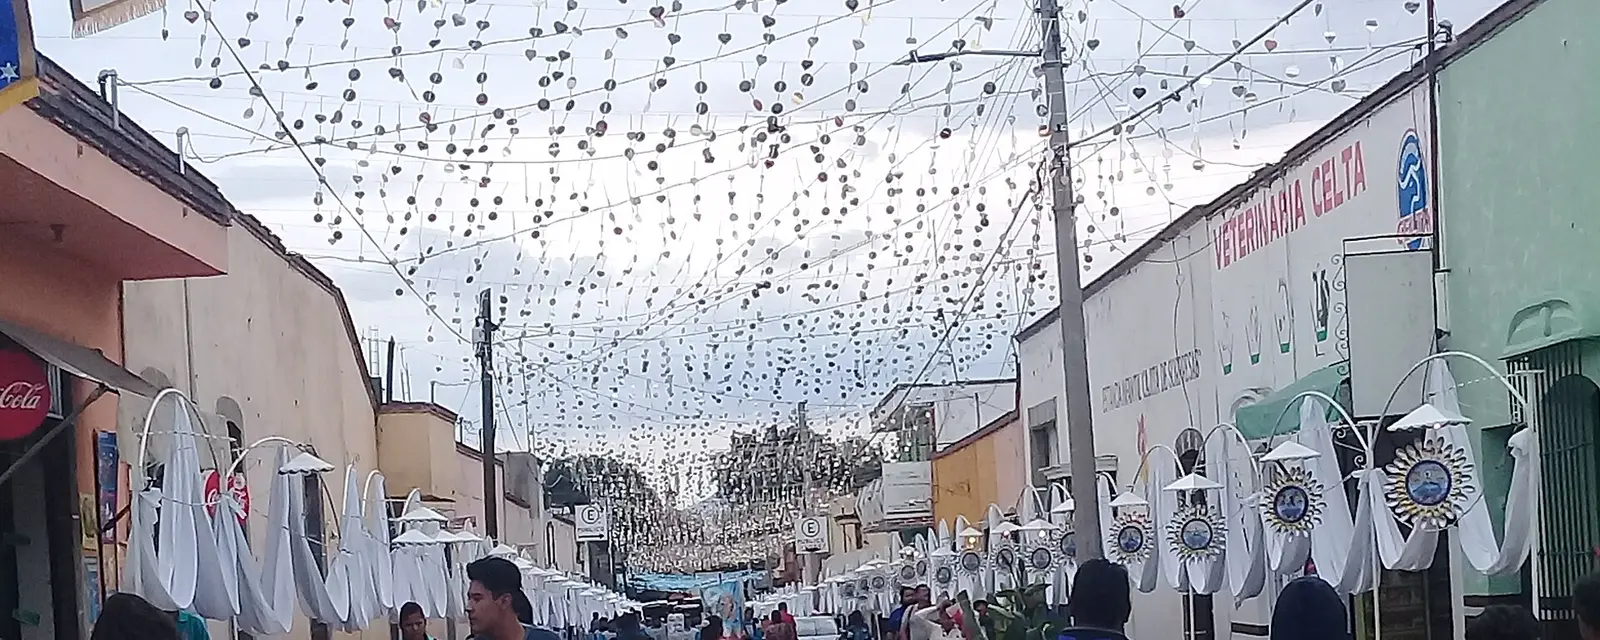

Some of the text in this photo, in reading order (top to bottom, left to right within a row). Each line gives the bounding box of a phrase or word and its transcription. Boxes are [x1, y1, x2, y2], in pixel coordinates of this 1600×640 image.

[1213, 141, 1366, 270] VETERINARIA CELTA
[588, 509, 594, 520] E
[808, 522, 815, 533] E
